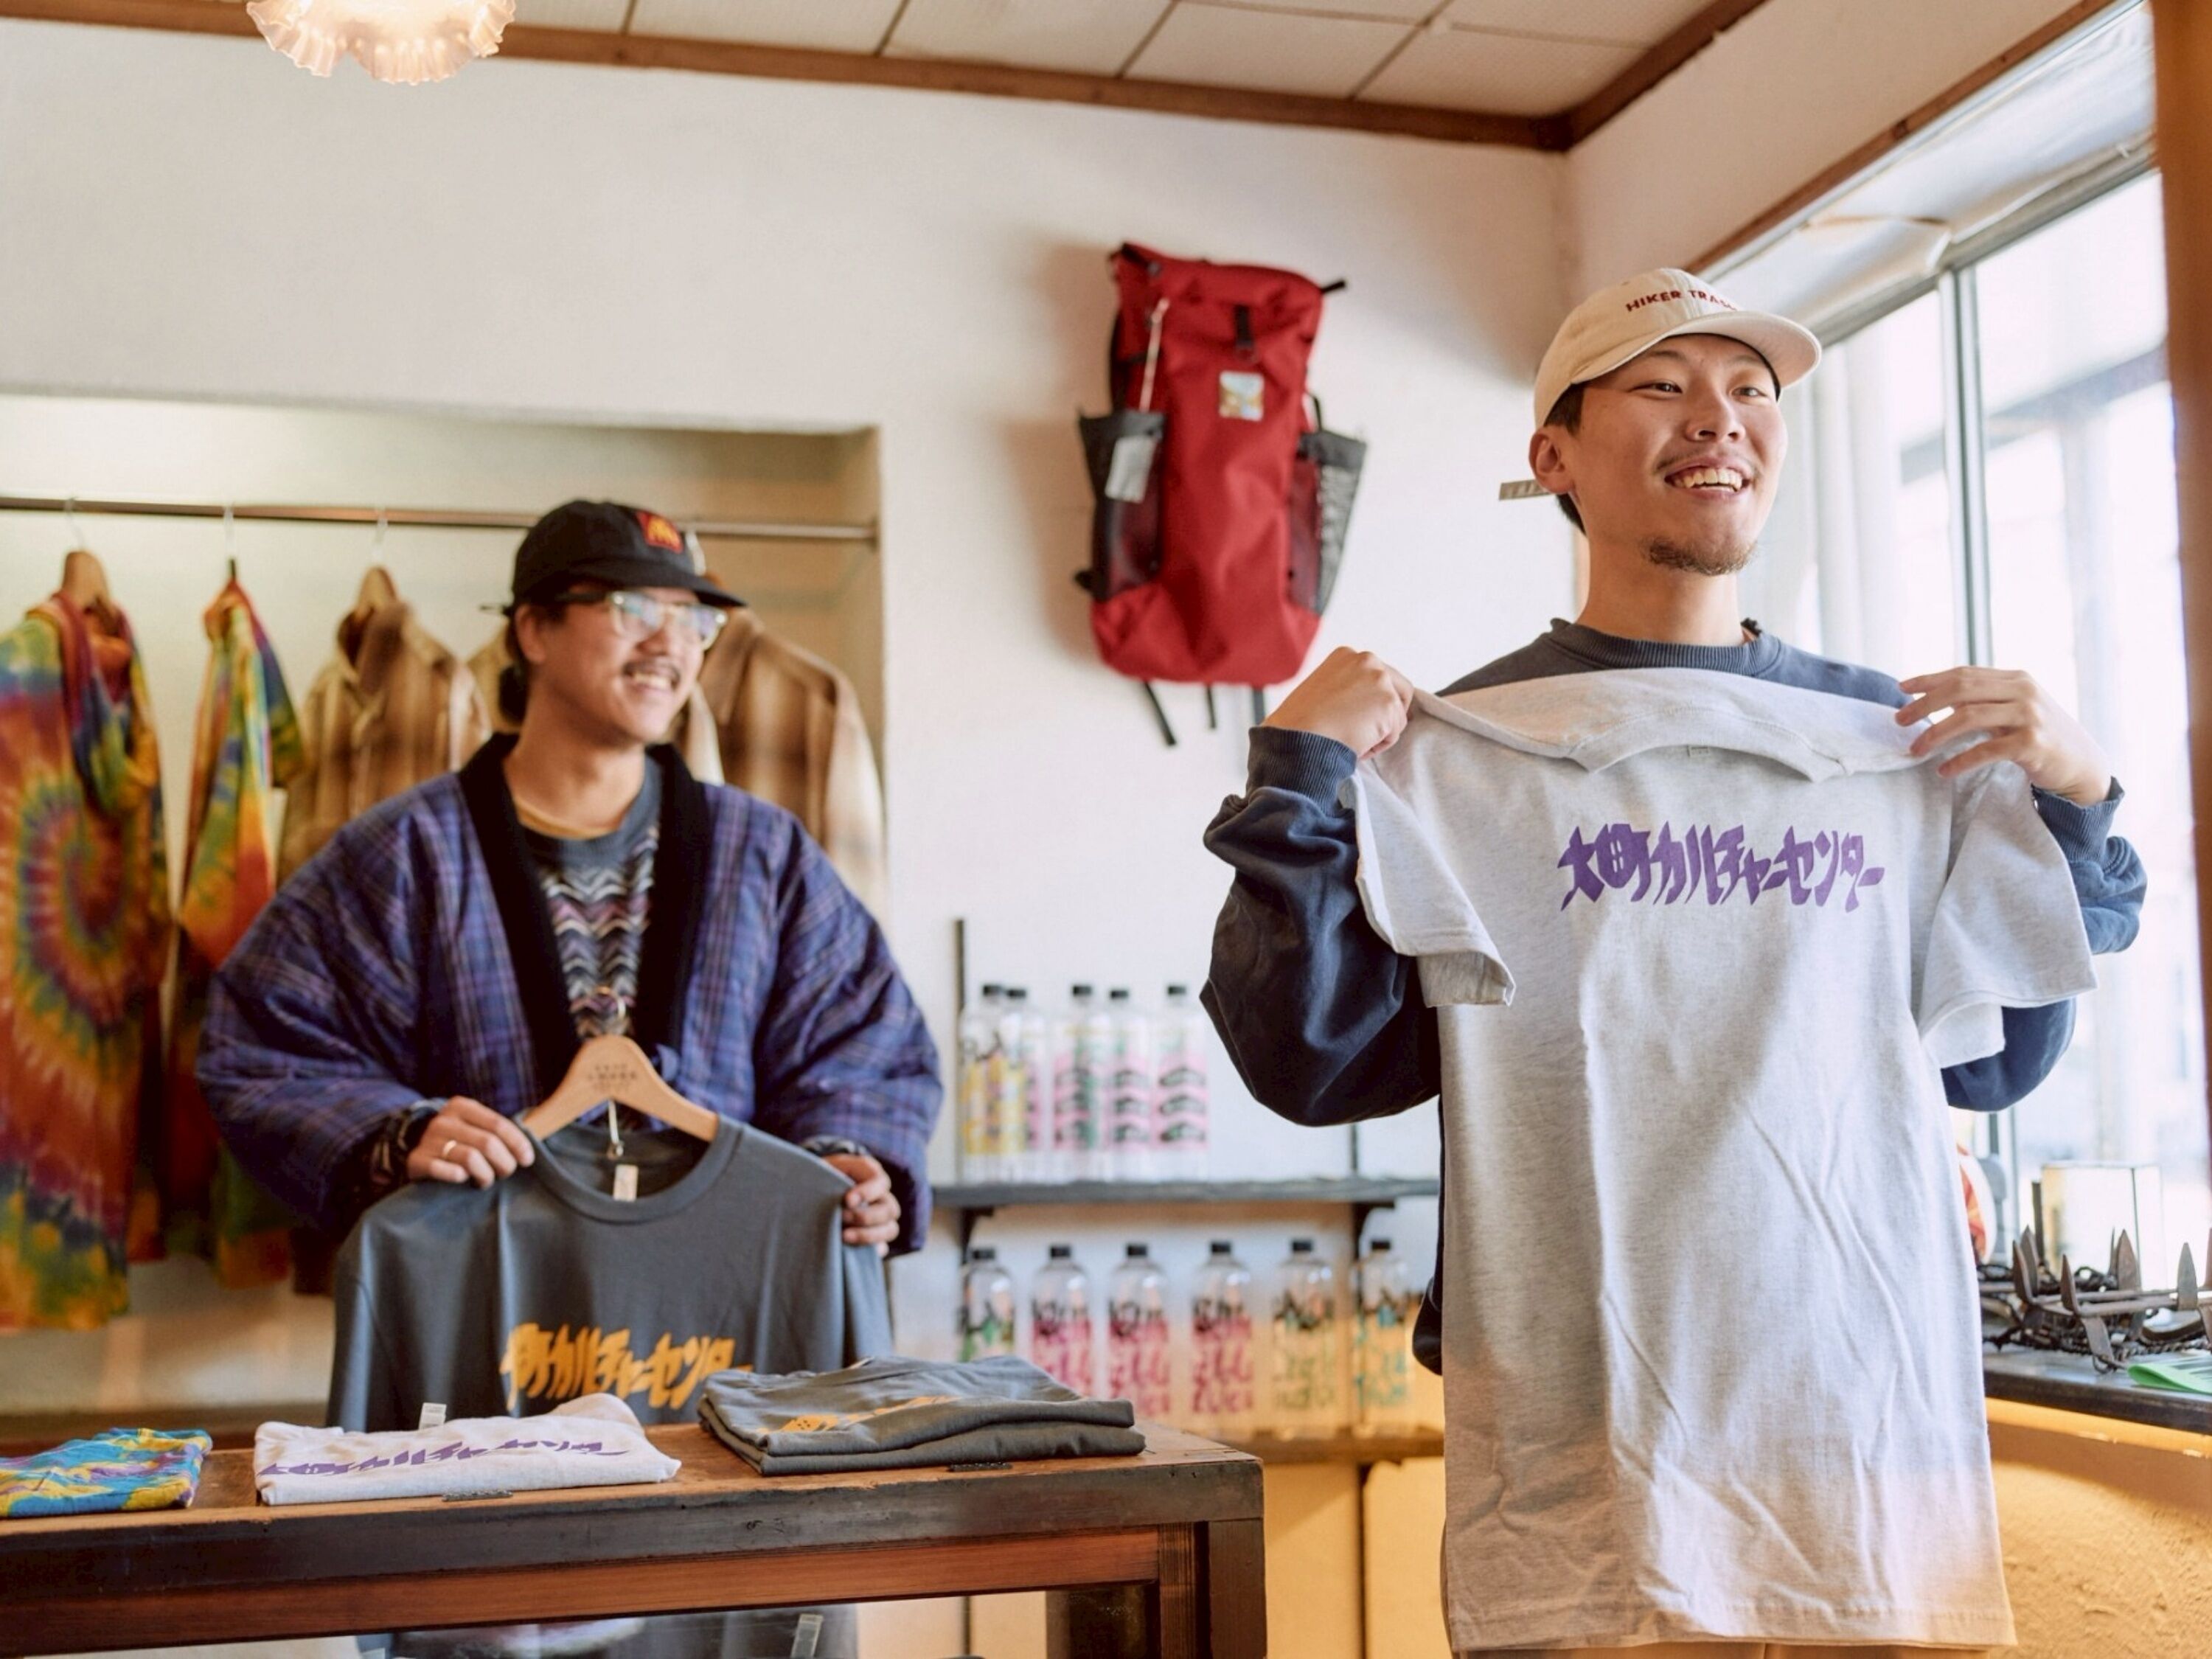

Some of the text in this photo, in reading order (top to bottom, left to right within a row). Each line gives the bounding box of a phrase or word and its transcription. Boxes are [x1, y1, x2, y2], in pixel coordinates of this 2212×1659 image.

[1625, 290, 1682, 313] HIKER
[1557, 821, 1885, 913] 大町カルチャーセンター
[499, 1322, 753, 1411] 町カルチャーセンタ
